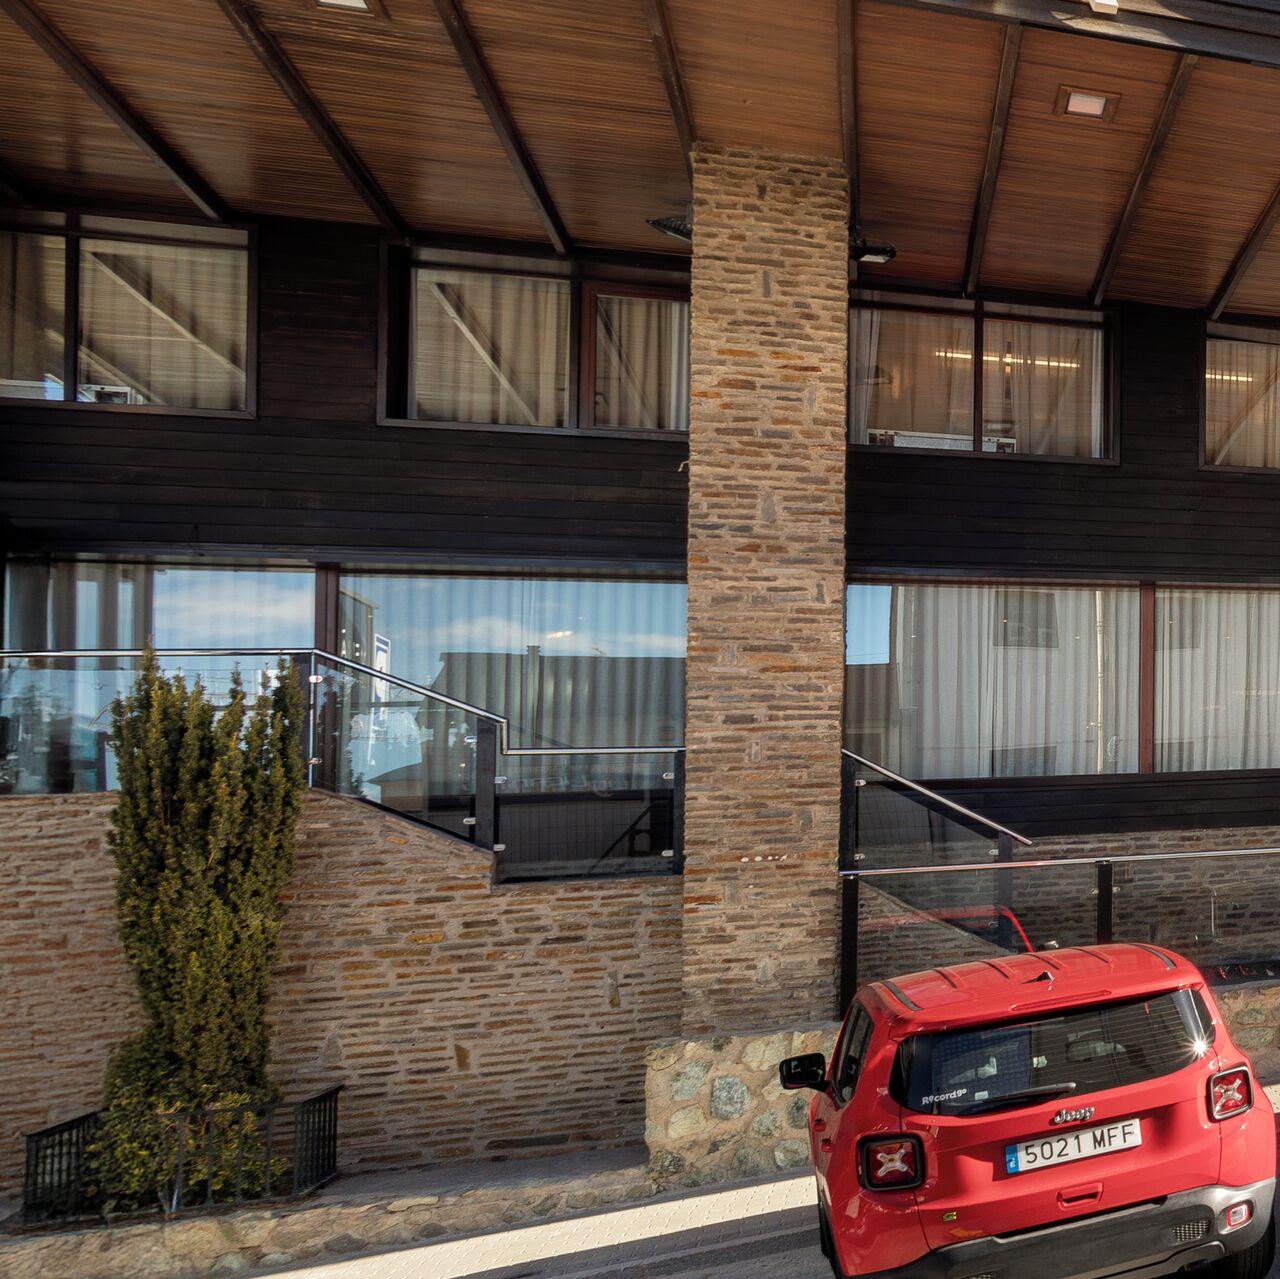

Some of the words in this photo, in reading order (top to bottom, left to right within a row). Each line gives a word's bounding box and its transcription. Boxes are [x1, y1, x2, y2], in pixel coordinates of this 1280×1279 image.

[1054, 1106, 1095, 1123] Jeep
[1025, 1134, 1082, 1164] 5021
[1093, 1123, 1135, 1150] MFF
